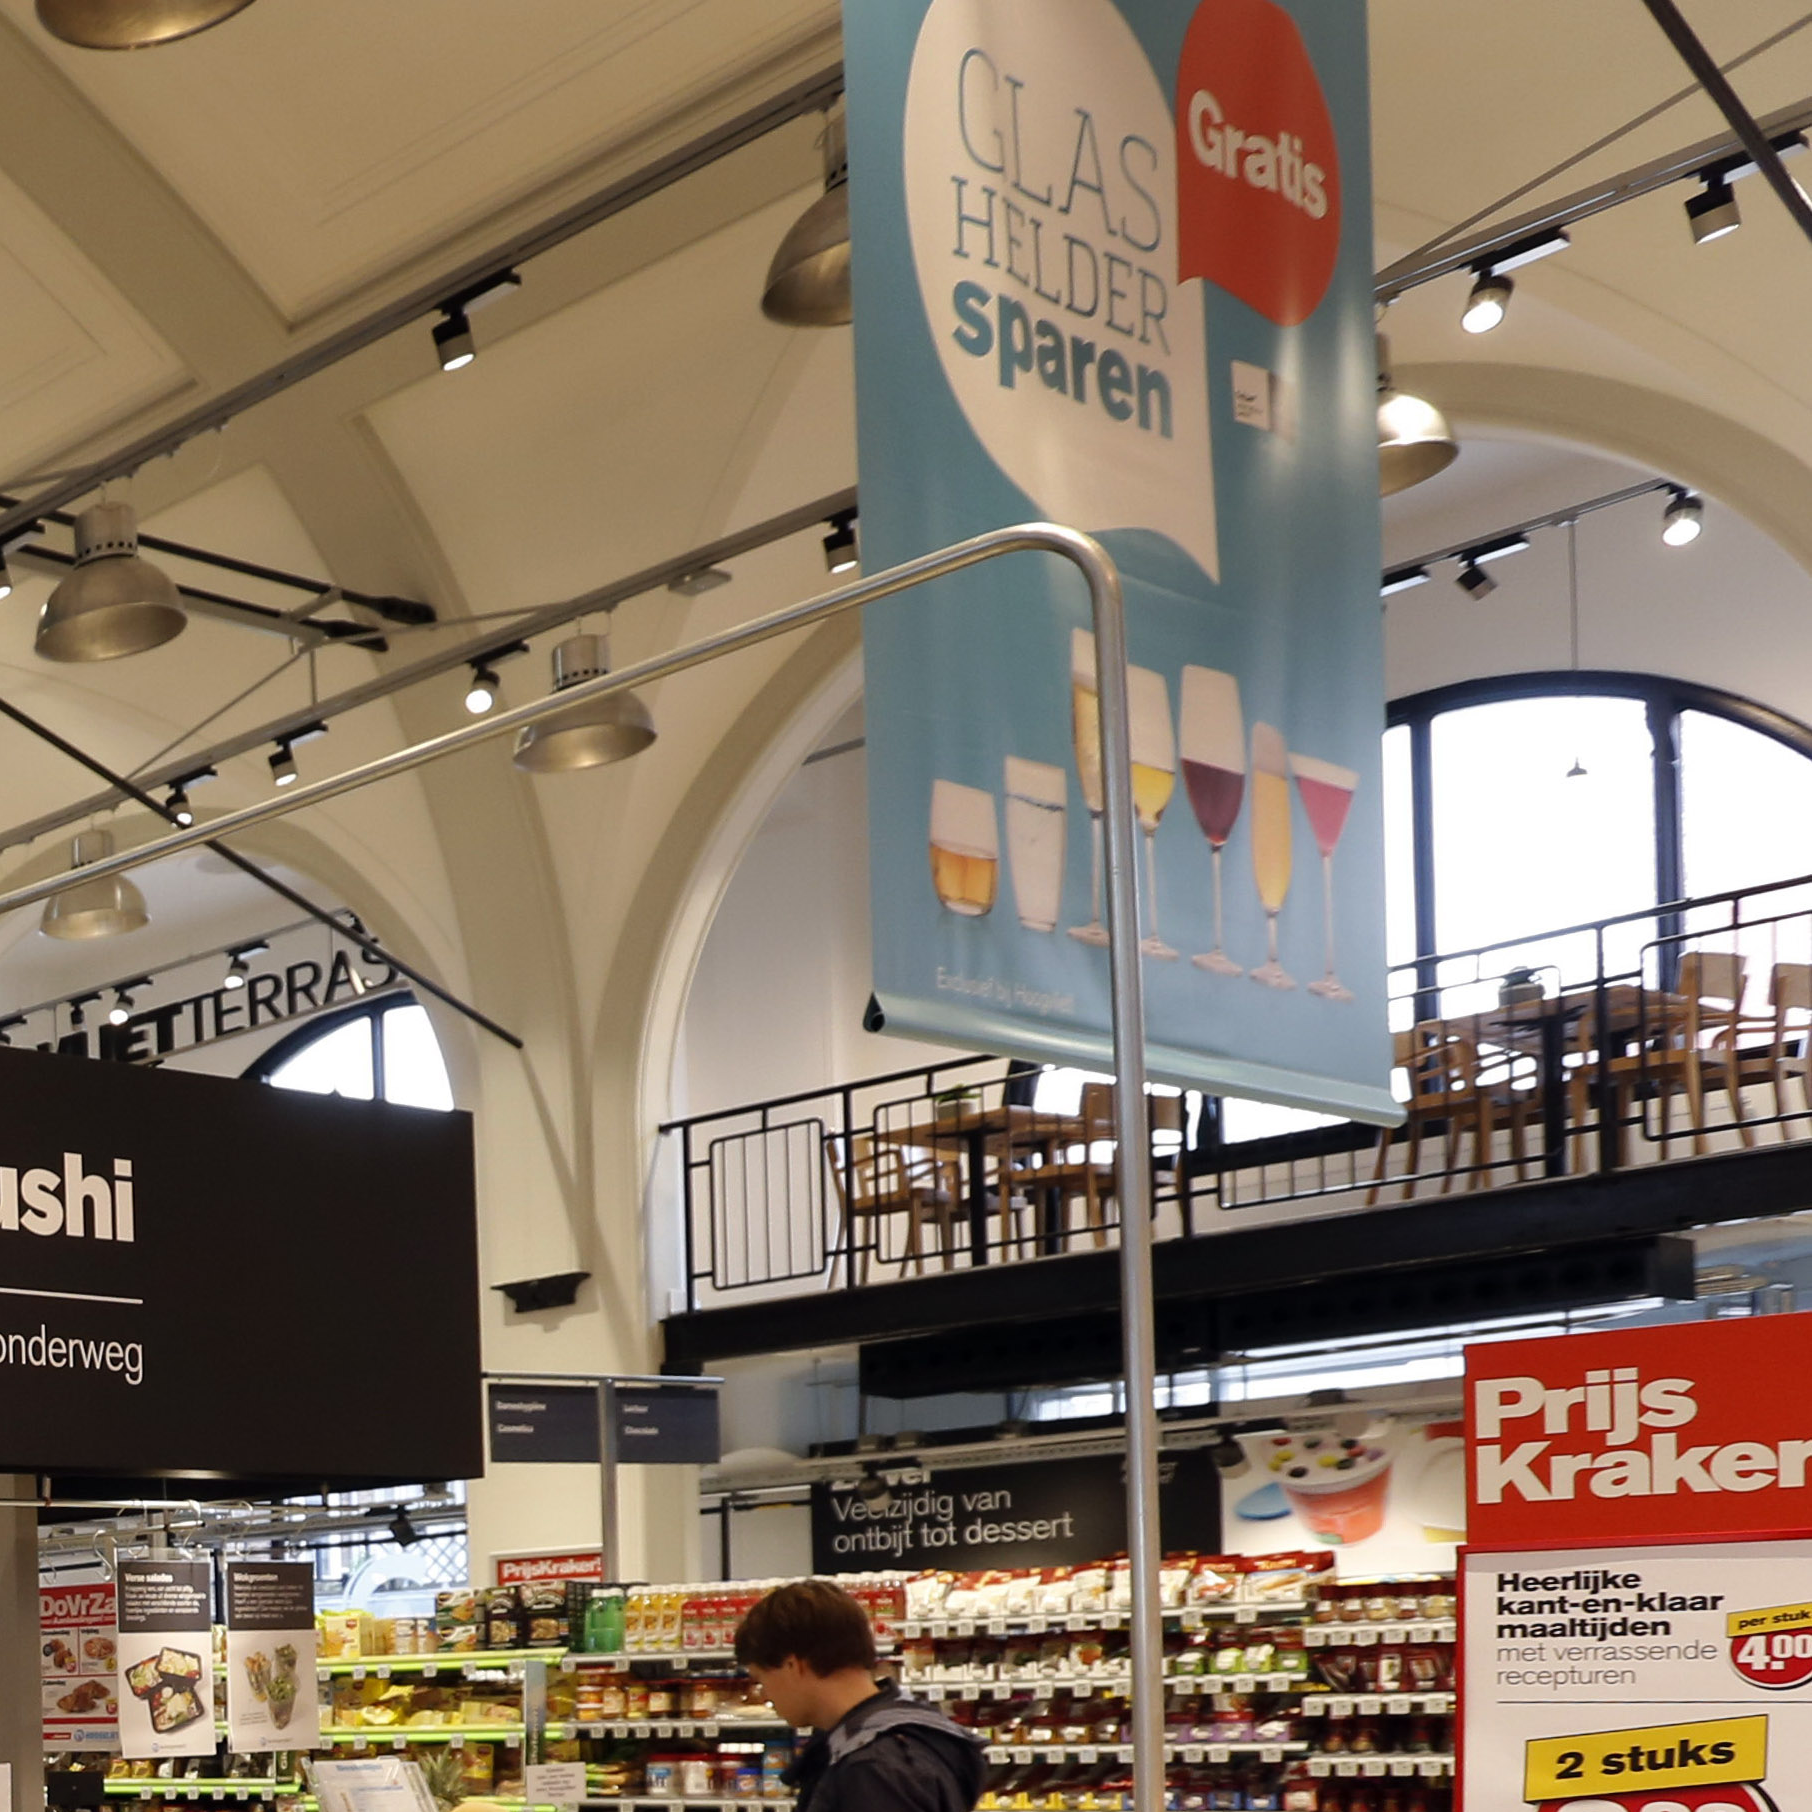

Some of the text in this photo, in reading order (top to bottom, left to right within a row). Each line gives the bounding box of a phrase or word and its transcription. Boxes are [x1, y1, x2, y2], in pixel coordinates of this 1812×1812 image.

[959, 48, 1162, 253] GLAS
[1188, 89, 1328, 220] Gratis
[951, 175, 1172, 355] HELDER
[952, 279, 1173, 440] sparen
[1475, 1366, 1698, 1447] Prijs
[961, 1489, 1012, 1513] van
[833, 1510, 1075, 1558] ontbijt tot dessert
[1496, 1570, 1642, 1597] Heerlijke
[39, 1591, 116, 1618] DoVrZa
[1496, 1591, 1725, 1617] kant-en-klaar
[1496, 1614, 1672, 1642] maaltijden
[1737, 1606, 1811, 1631] per stuk
[1496, 1640, 1718, 1663] met verrassende
[1496, 1666, 1637, 1690] recepturen
[1554, 1738, 1736, 1780] 2 stuks
